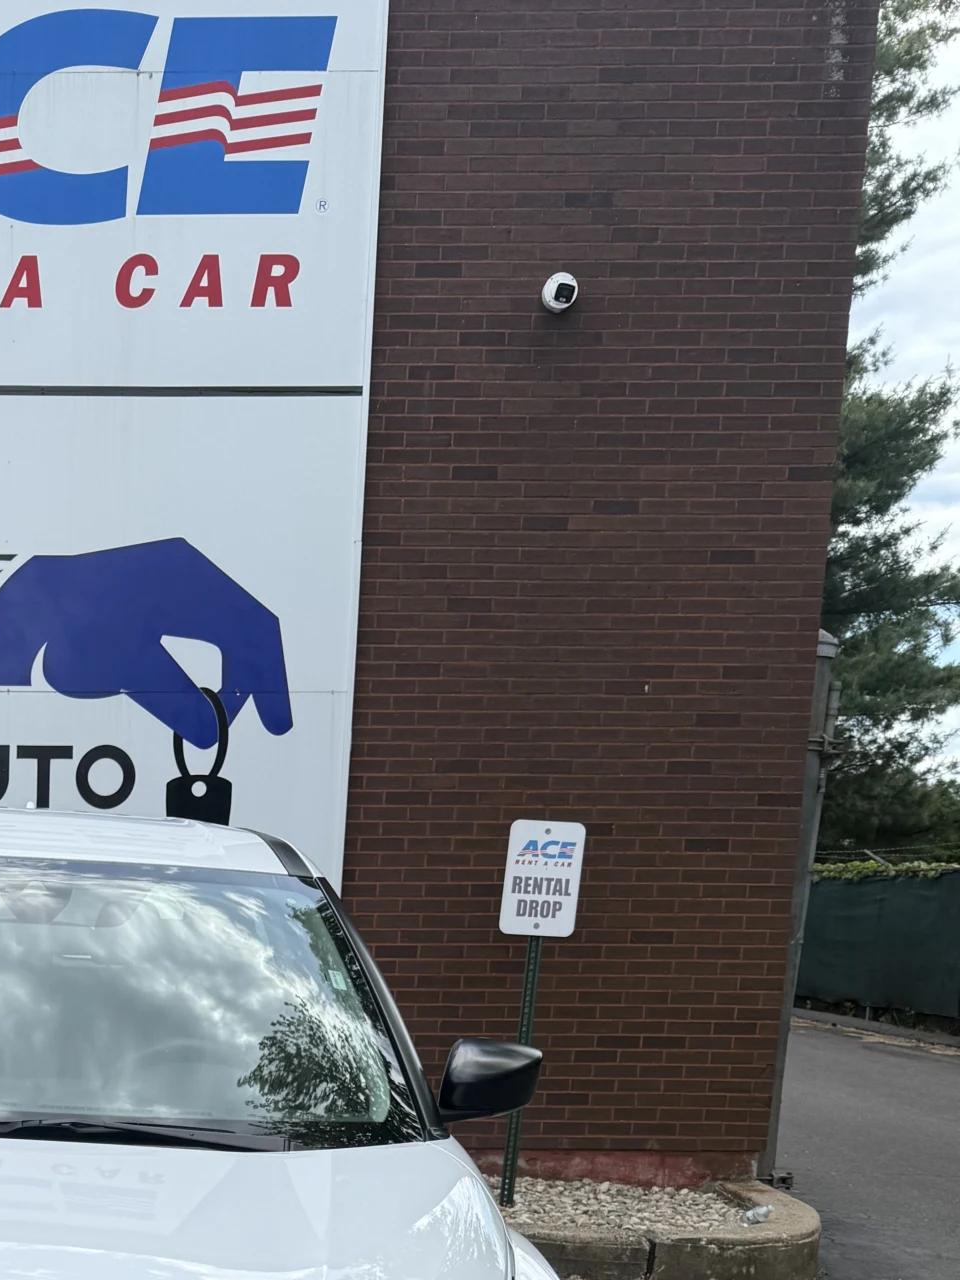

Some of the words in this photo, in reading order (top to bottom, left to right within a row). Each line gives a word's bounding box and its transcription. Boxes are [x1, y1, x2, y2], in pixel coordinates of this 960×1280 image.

[0, 254, 44, 310] A
[113, 253, 301, 309] CAR
[517, 840, 577, 859] ACE
[511, 875, 572, 897] RENTAL
[515, 899, 563, 919] DROP
